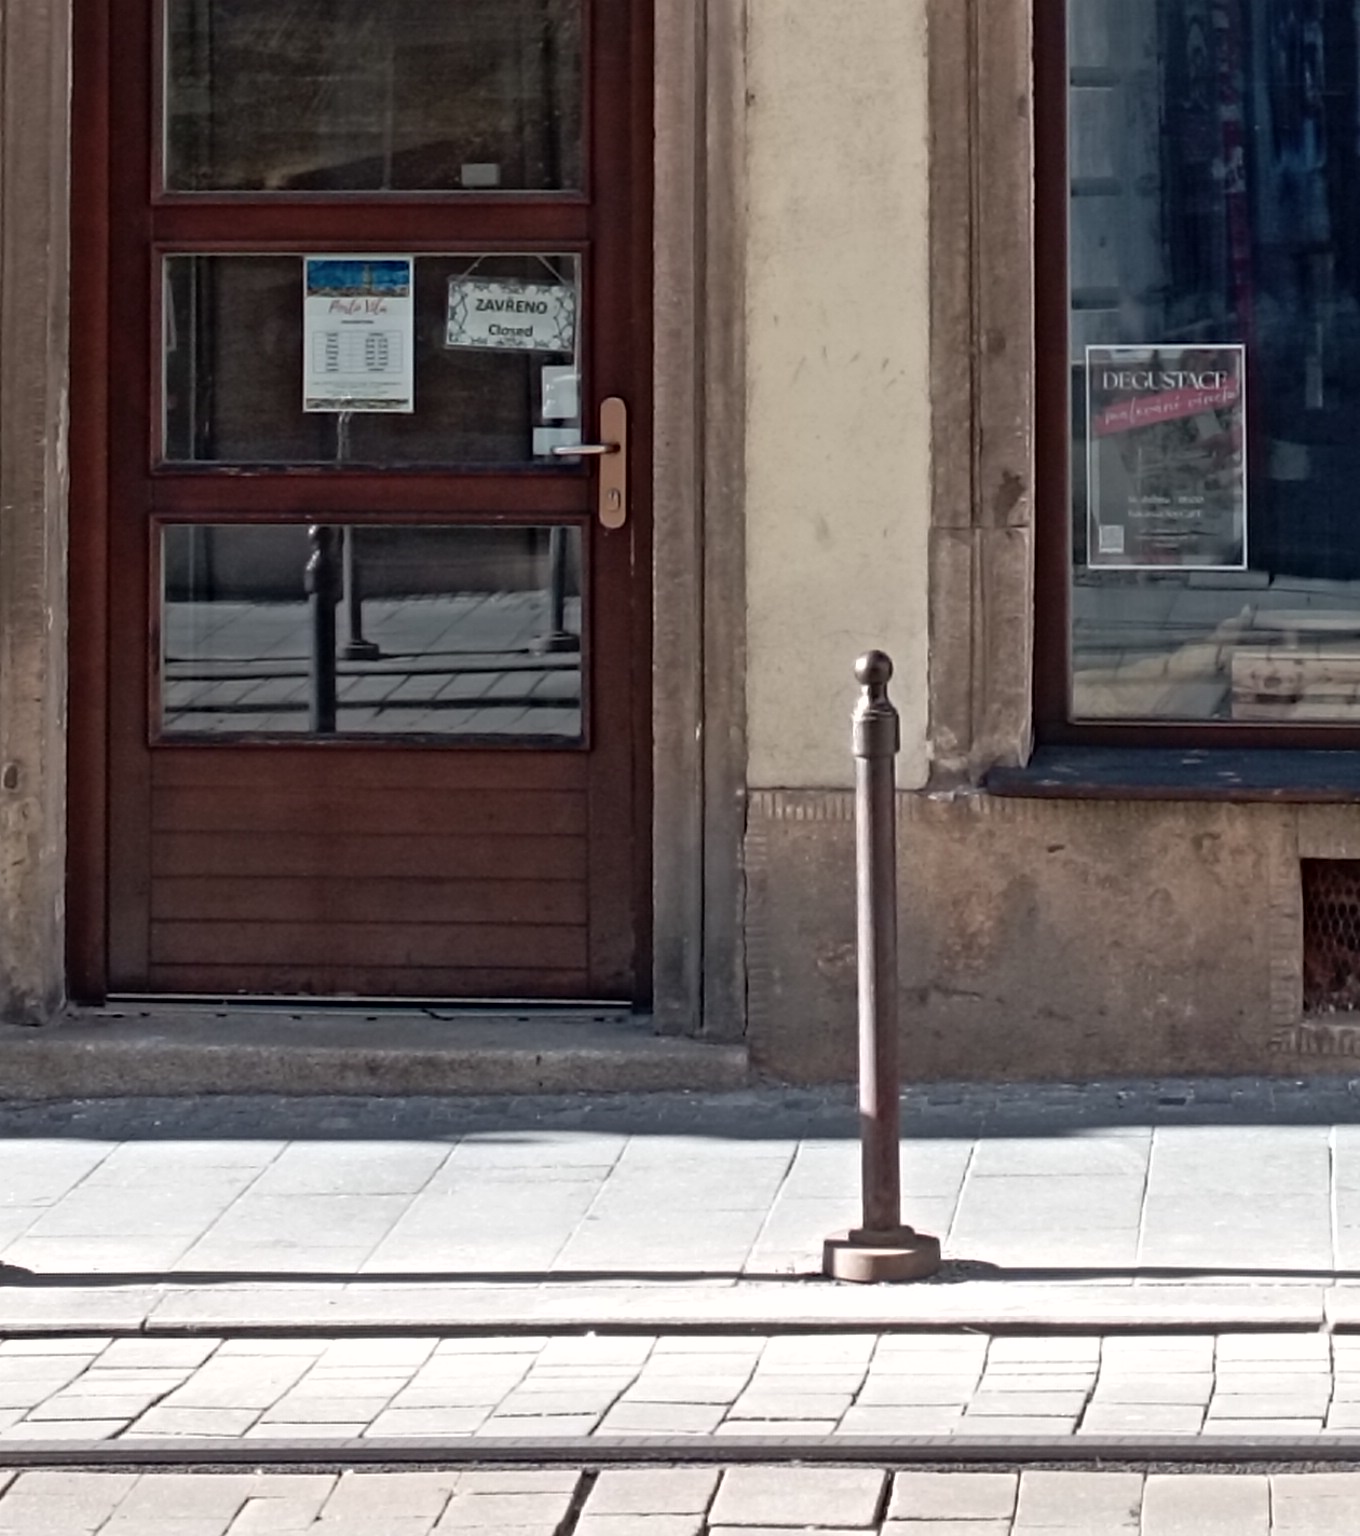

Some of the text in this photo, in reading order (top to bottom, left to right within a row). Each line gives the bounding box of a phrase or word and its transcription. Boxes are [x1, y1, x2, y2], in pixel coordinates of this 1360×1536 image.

[475, 297, 548, 315] ZAVŘENO
[488, 324, 534, 337] Closed
[1103, 370, 1228, 391] DEGUSTACE
